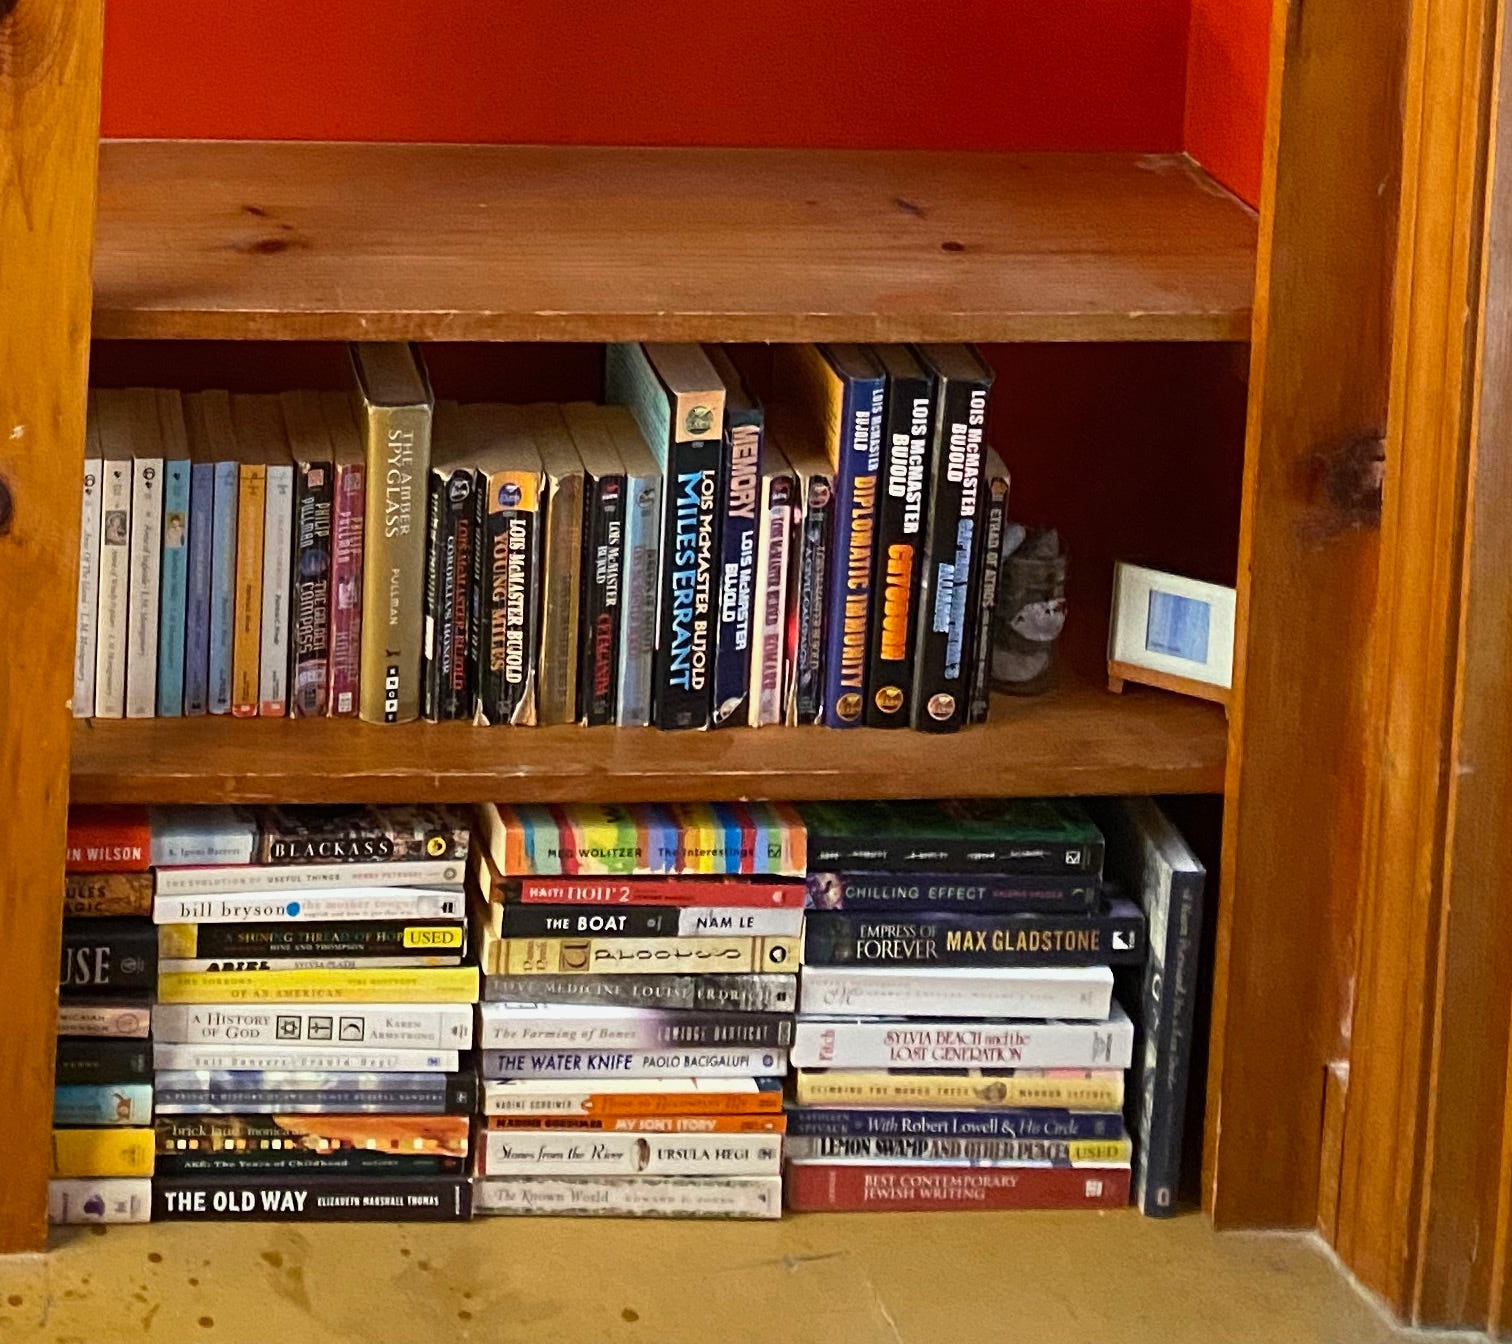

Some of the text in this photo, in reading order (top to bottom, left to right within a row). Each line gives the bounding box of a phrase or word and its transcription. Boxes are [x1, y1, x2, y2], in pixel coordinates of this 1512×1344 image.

[947, 423, 968, 482] BUJOLD
[960, 390, 985, 517] LOIS McMASTER
[385, 429, 401, 538] SPYGLASS
[669, 471, 701, 690] MILES ERRANT
[181, 902, 287, 920] bill bryson
[546, 916, 627, 931] THE BOAT
[696, 916, 754, 929] NAM LE
[410, 929, 454, 944] USED
[947, 930, 1100, 951] MAX GLADSTONE
[497, 1055, 632, 1071] THE WATER KNIFE
[165, 1191, 307, 1212] THE OLD WAY
